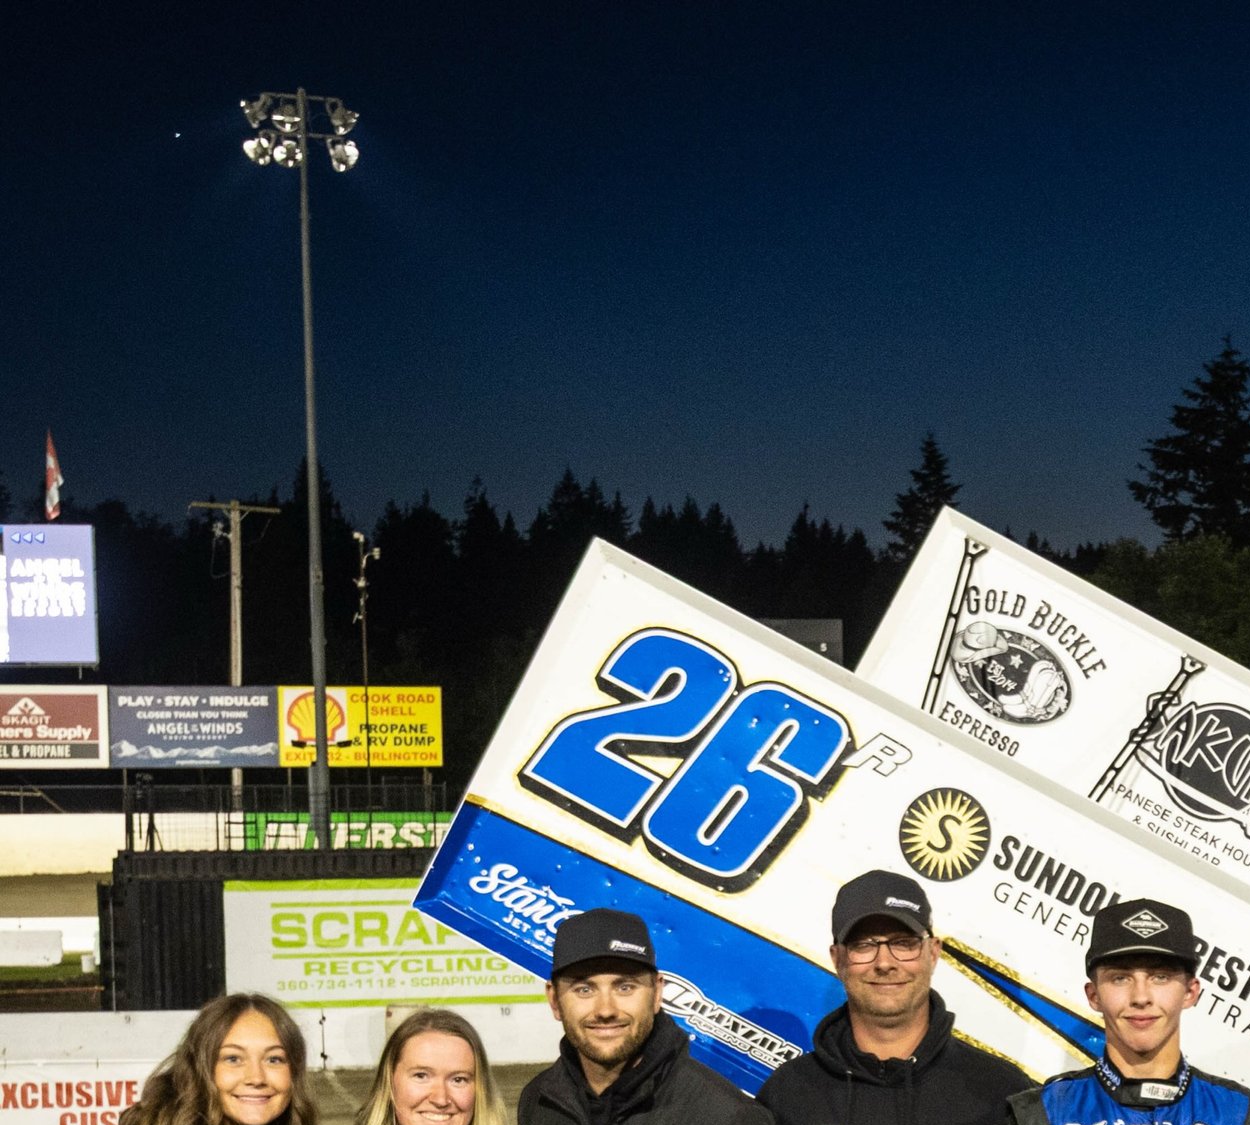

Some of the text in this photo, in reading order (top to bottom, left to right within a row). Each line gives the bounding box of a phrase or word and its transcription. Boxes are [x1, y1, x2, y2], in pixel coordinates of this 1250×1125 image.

[966, 585, 1107, 680] GOLD BUCKLE
[117, 695, 269, 707] PLAY STAY INDULGE
[350, 693, 435, 704] COOK ROAD
[136, 710, 248, 719] CLOSER THAN YOU THINK
[370, 706, 416, 716] SHELL
[1, 715, 51, 725] SKAGIT
[147, 723, 190, 734] ANGEL
[199, 722, 243, 734] WINDS
[37, 724, 92, 740] Supply
[359, 723, 428, 734] PROPANE
[938, 701, 1021, 757] ESPRESSO
[352, 736, 435, 746] & RV DUMP
[13, 743, 71, 757] & PROPANE
[285, 751, 317, 762] EXIT
[354, 751, 438, 762] BURLINGTON
[841, 732, 913, 777] R
[516, 626, 857, 895] 26
[1106, 781, 1173, 823] APANESE
[1173, 815, 1222, 849] STEAK
[1132, 815, 1142, 826] &
[263, 821, 451, 851] INERST
[926, 814, 962, 854] S
[992, 835, 1122, 920] SUNDO
[502, 914, 532, 936] JET
[303, 958, 509, 976] RECYCLING
[410, 974, 536, 987] SCRAPITWA.COM
[689, 1015, 749, 1050] RACING
[0, 1080, 139, 1109] XCLUSIVE
